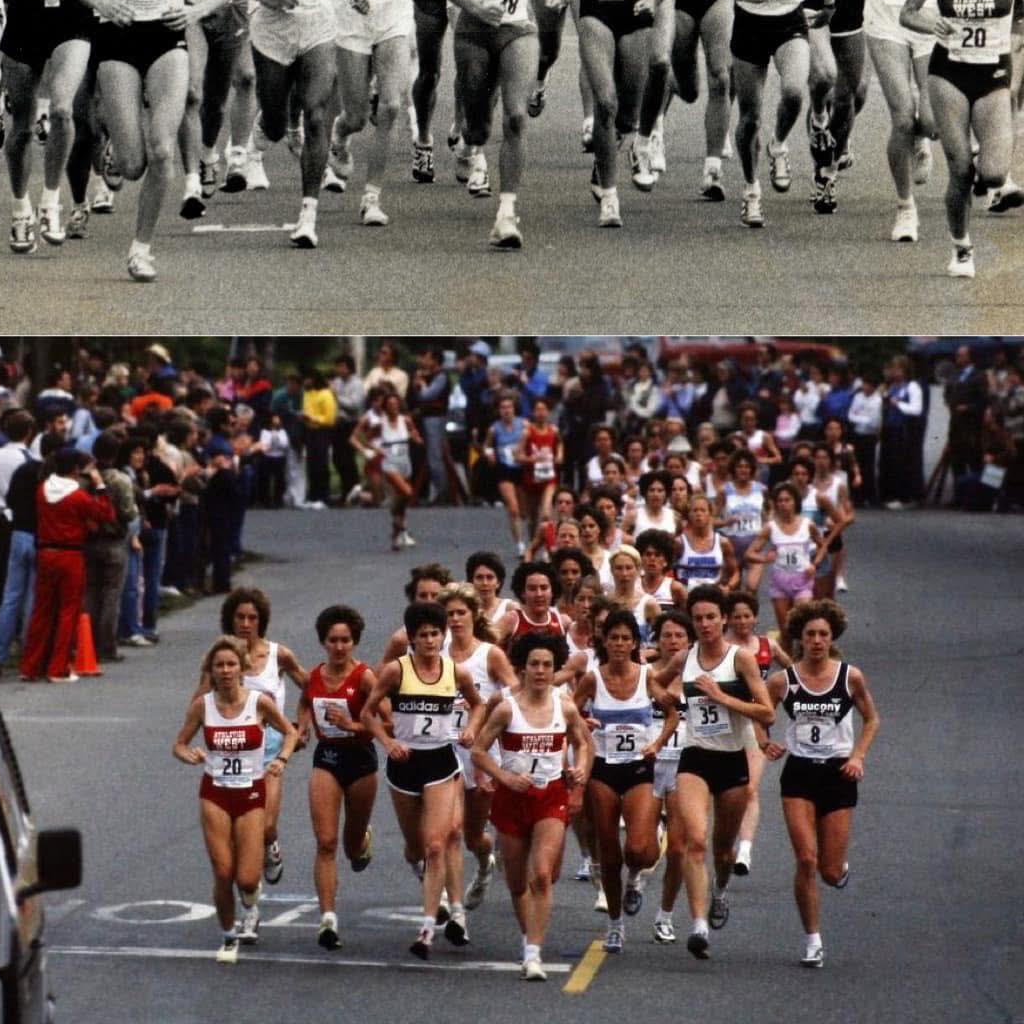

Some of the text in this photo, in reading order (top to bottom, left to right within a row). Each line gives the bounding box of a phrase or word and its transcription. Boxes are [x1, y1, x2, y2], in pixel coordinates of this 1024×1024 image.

[953, 2, 996, 17] WEST
[961, 26, 986, 48] 20
[399, 700, 440, 712] adidas
[699, 705, 719, 725] 35
[793, 701, 841, 714] Saucony
[421, 717, 433, 735] 2
[810, 725, 821, 744] 8
[616, 734, 635, 752] 25
[222, 758, 242, 775] 20
